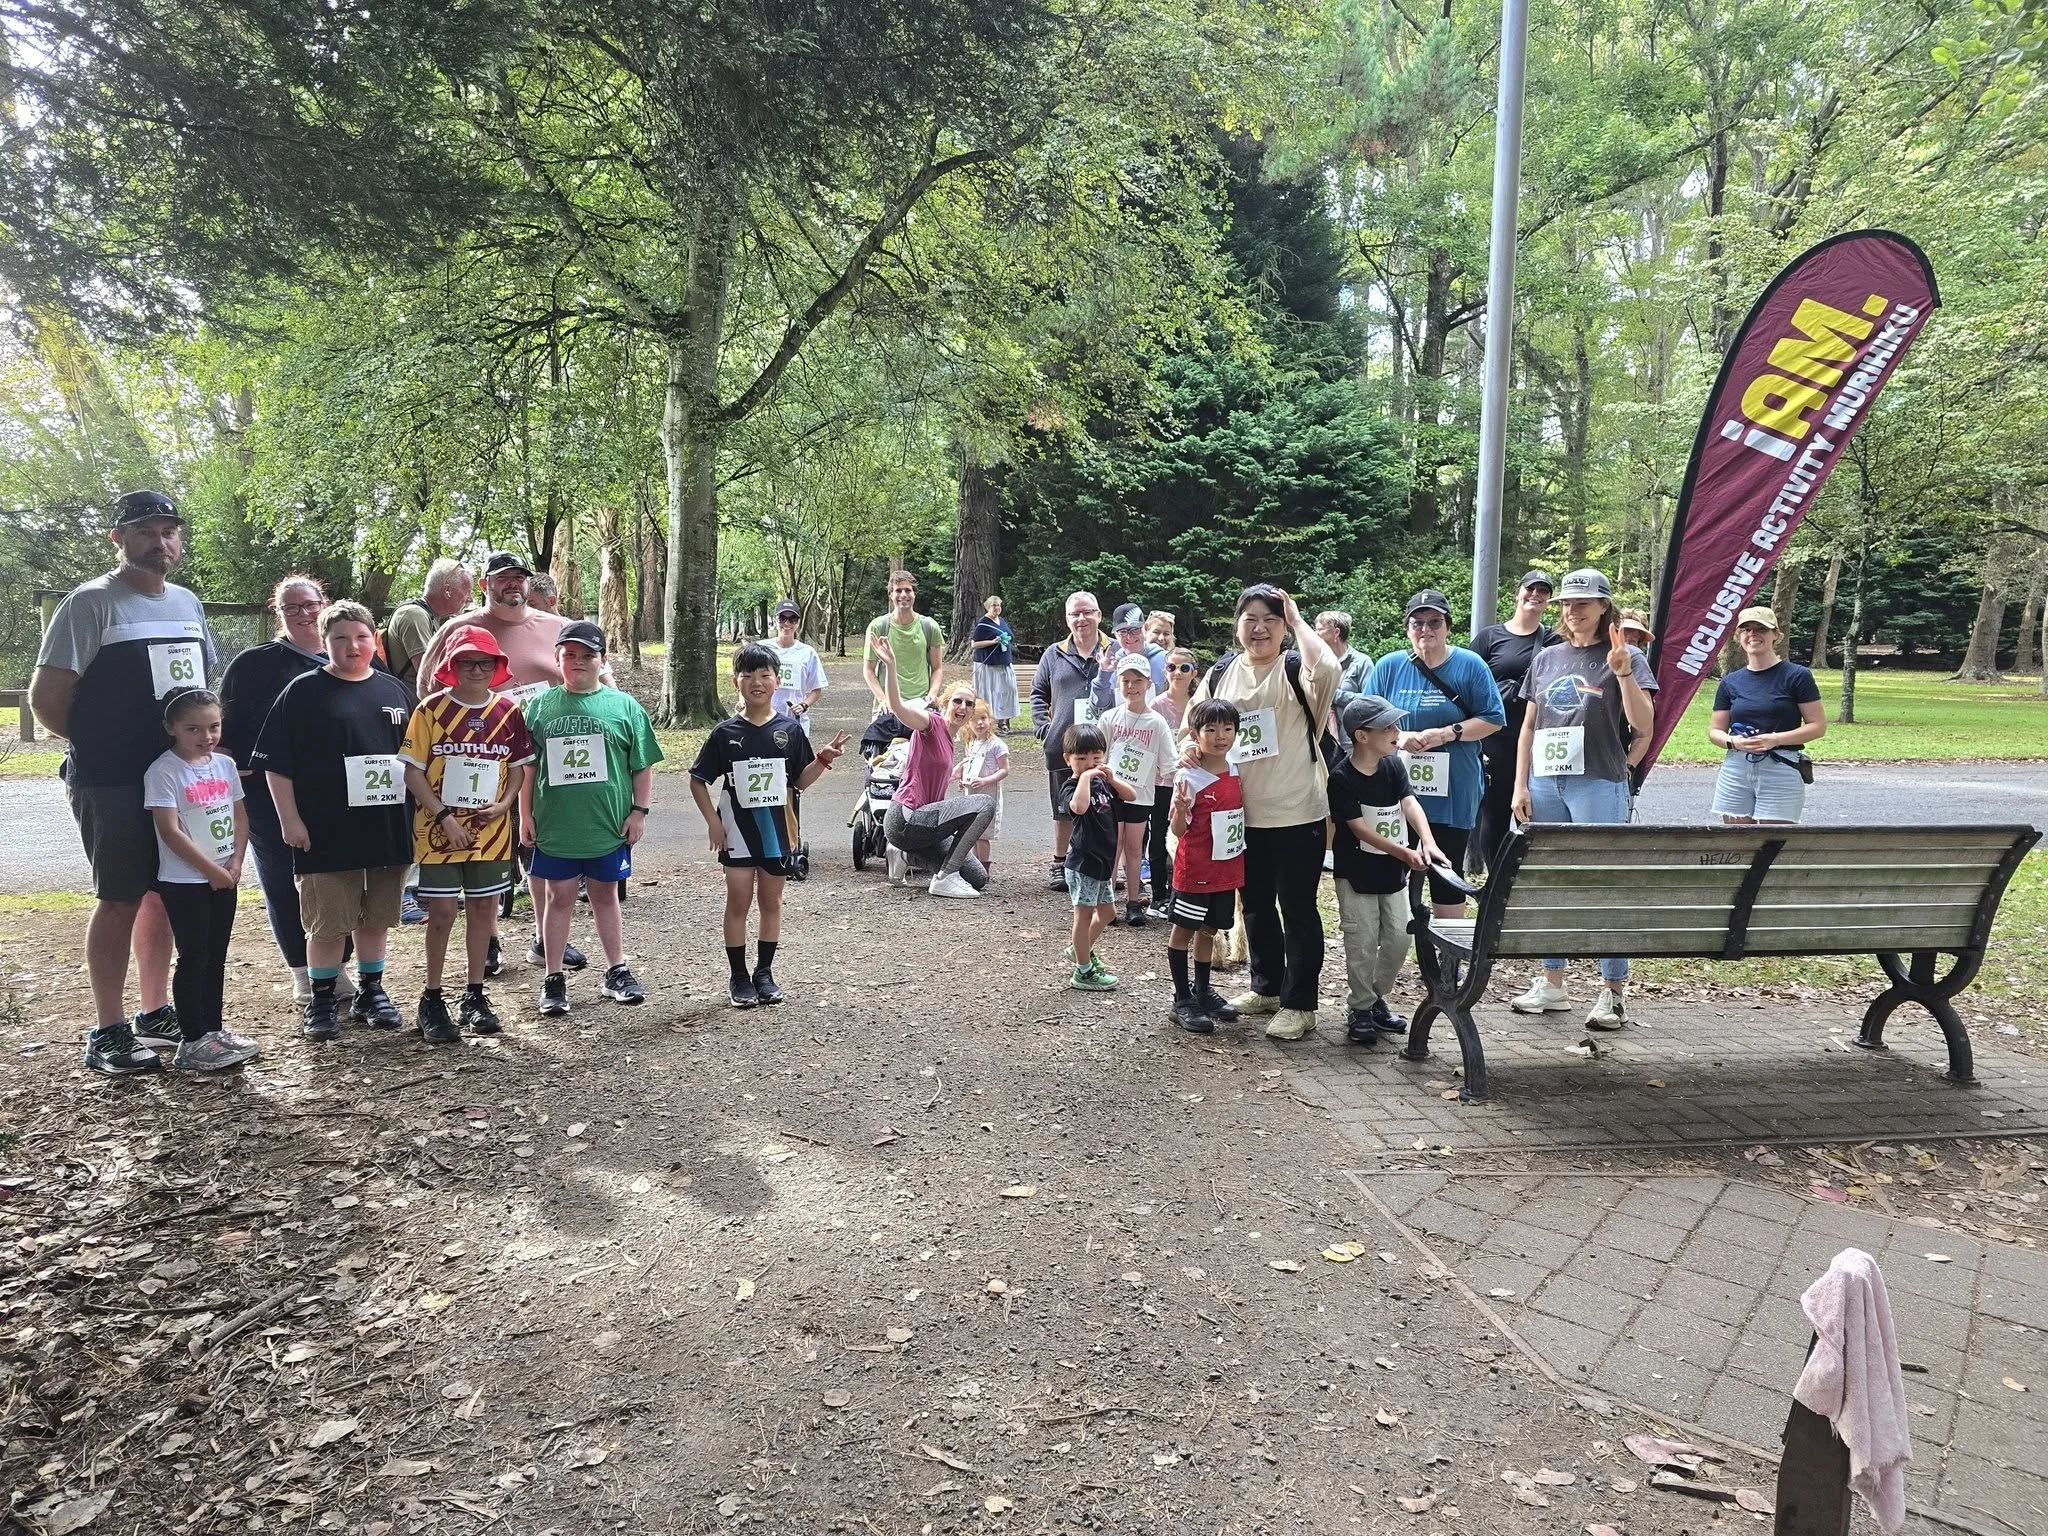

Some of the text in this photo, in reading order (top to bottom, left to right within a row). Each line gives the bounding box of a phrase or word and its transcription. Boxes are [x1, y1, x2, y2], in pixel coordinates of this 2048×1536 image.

[1676, 303, 1919, 677] INCLUSIVE ACTIVITY MURIHIKU
[169, 659, 194, 680] 63
[1112, 724, 1153, 749] CHAMPION
[1238, 725, 1262, 747] 29
[563, 749, 590, 768] 42
[1252, 747, 1268, 756] 2KM
[1544, 741, 1568, 760] 65
[1118, 755, 1140, 773] 33
[1409, 764, 1434, 782] 68
[364, 769, 393, 790] 24
[469, 772, 480, 793] 1
[748, 772, 774, 792] 27
[1124, 774, 1138, 783] 2KM
[209, 816, 234, 841] 62
[1227, 821, 1243, 843] 28
[1375, 819, 1401, 839] 66
[1700, 852, 1741, 865] HELLO
